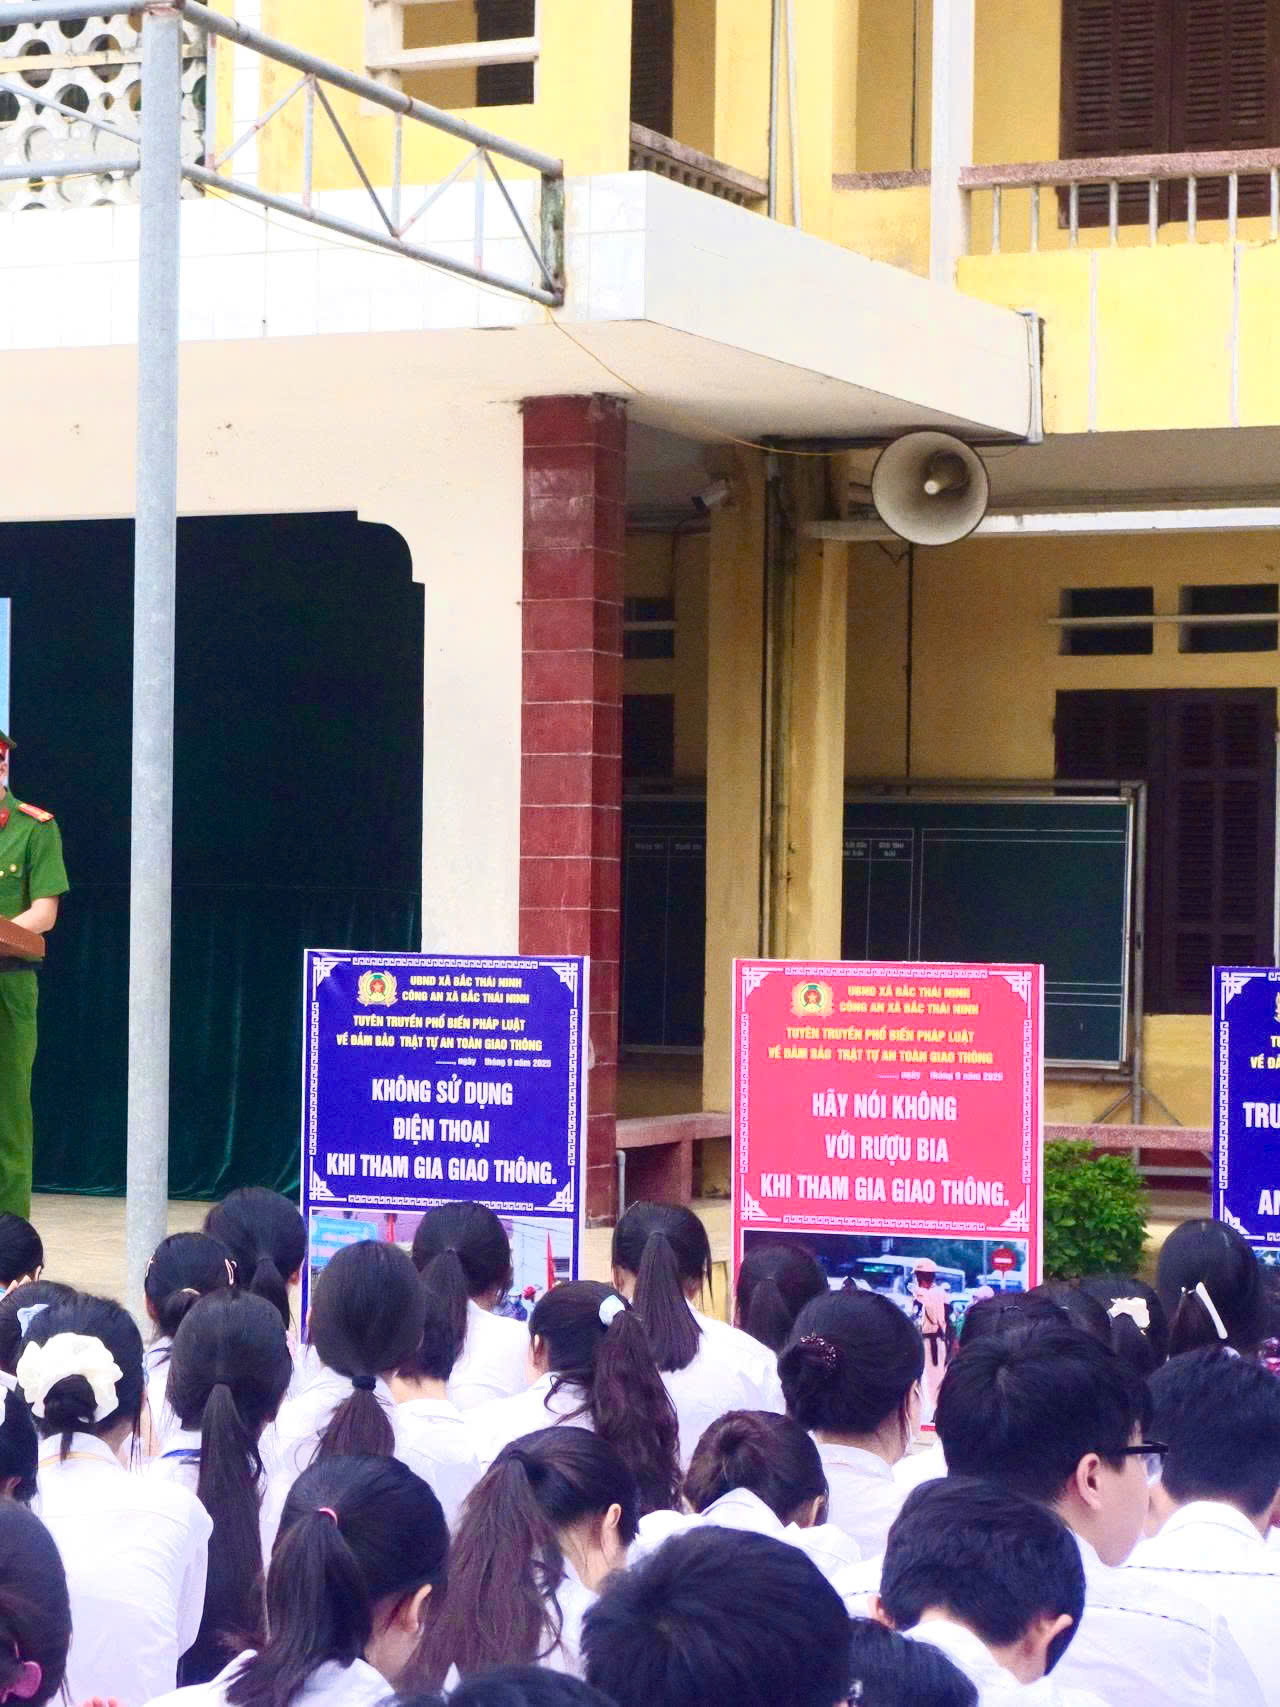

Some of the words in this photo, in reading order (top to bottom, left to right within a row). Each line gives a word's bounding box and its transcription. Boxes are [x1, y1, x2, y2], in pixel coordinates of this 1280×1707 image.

[410, 975, 435, 986] UBND
[430, 991, 443, 1002] AN
[353, 1015, 384, 1027] TUYÊN
[502, 1017, 526, 1032] LUẬT
[400, 1035, 422, 1050] TRẬT
[440, 1037, 455, 1048] AN
[457, 1036, 482, 1049] TOÀN
[485, 1039, 508, 1050] GIAO
[510, 1037, 542, 1051] THÔNG
[372, 1074, 431, 1102] KHÔNG
[436, 1073, 462, 1104] SỬ
[465, 1081, 513, 1110] DỤNG
[812, 1088, 848, 1117] HÃY
[854, 1089, 886, 1119] NÓI
[892, 1091, 957, 1120] KHÔNG
[393, 1113, 434, 1145] ĐIỆN
[439, 1119, 490, 1148] THOẠI
[825, 1129, 855, 1159] VỚI
[861, 1134, 911, 1166] RƯỢU
[917, 1137, 949, 1162] BIA
[326, 1153, 355, 1176] KHI
[360, 1154, 409, 1178] THAM
[414, 1156, 443, 1179] GIA
[448, 1158, 488, 1182] GIAO
[493, 1156, 557, 1185] THÔNG.
[760, 1173, 791, 1198] KHI
[796, 1175, 849, 1200] THAM
[855, 1177, 886, 1201] GIA
[892, 1178, 935, 1204] GIAO
[941, 1176, 1009, 1206] THÔNG.
